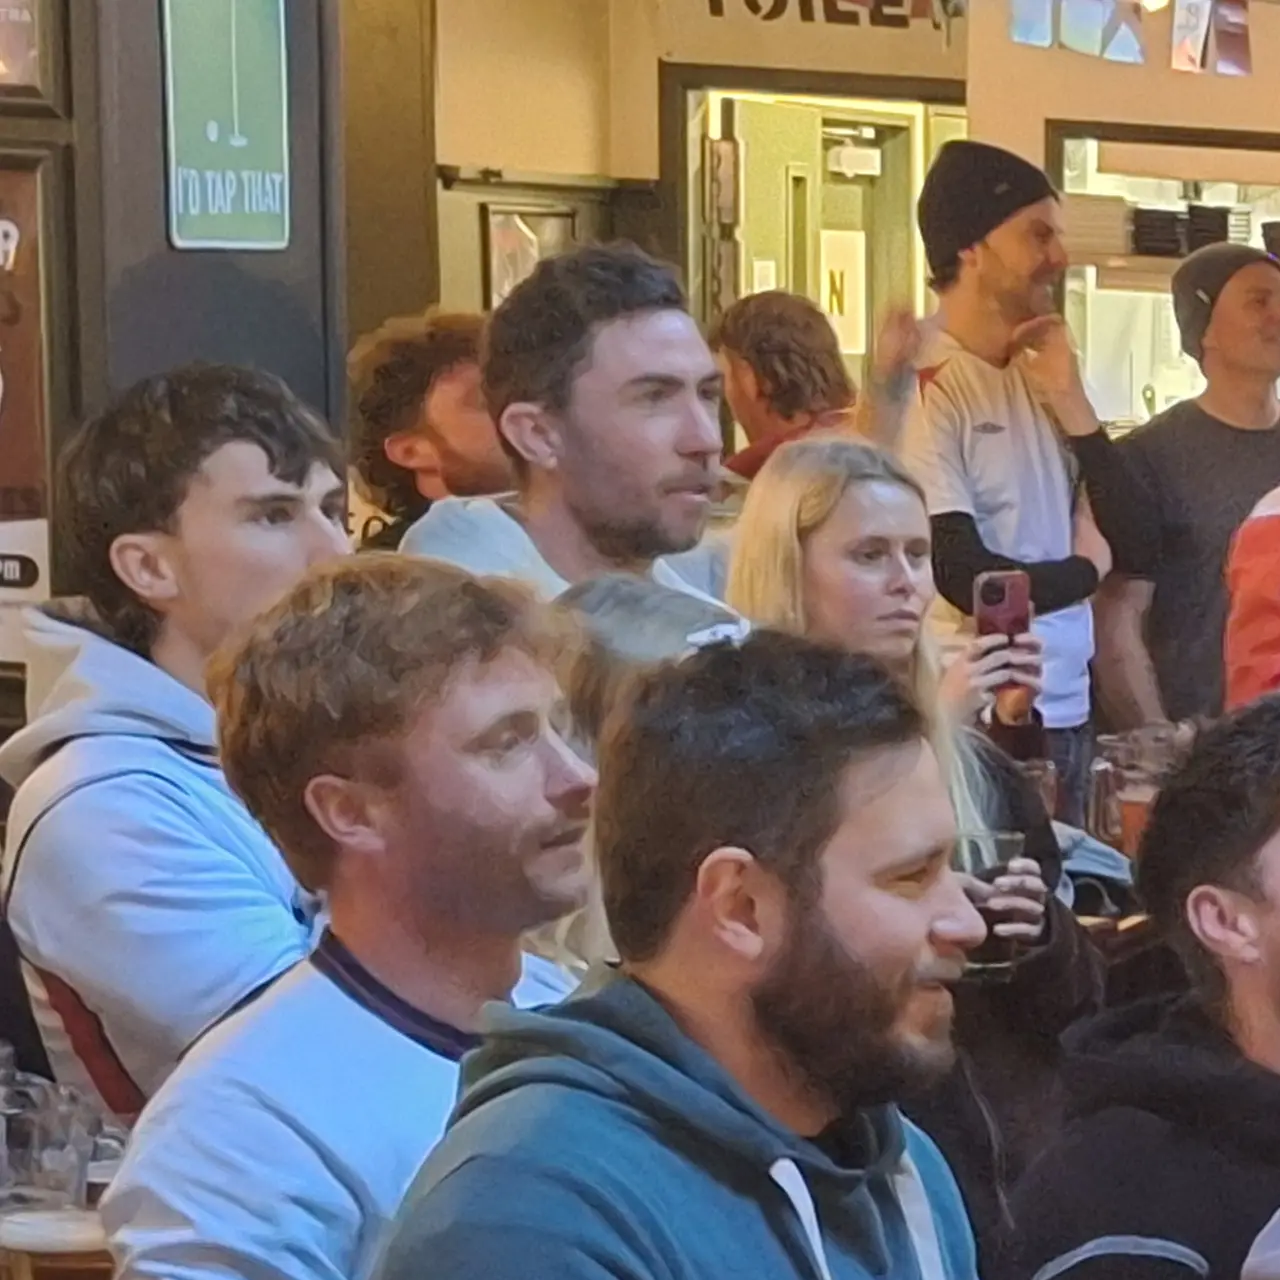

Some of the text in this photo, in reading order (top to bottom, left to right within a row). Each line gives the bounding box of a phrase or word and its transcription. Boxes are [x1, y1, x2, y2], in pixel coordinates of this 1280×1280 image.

[178, 167, 283, 215] I'D TAP THAT
